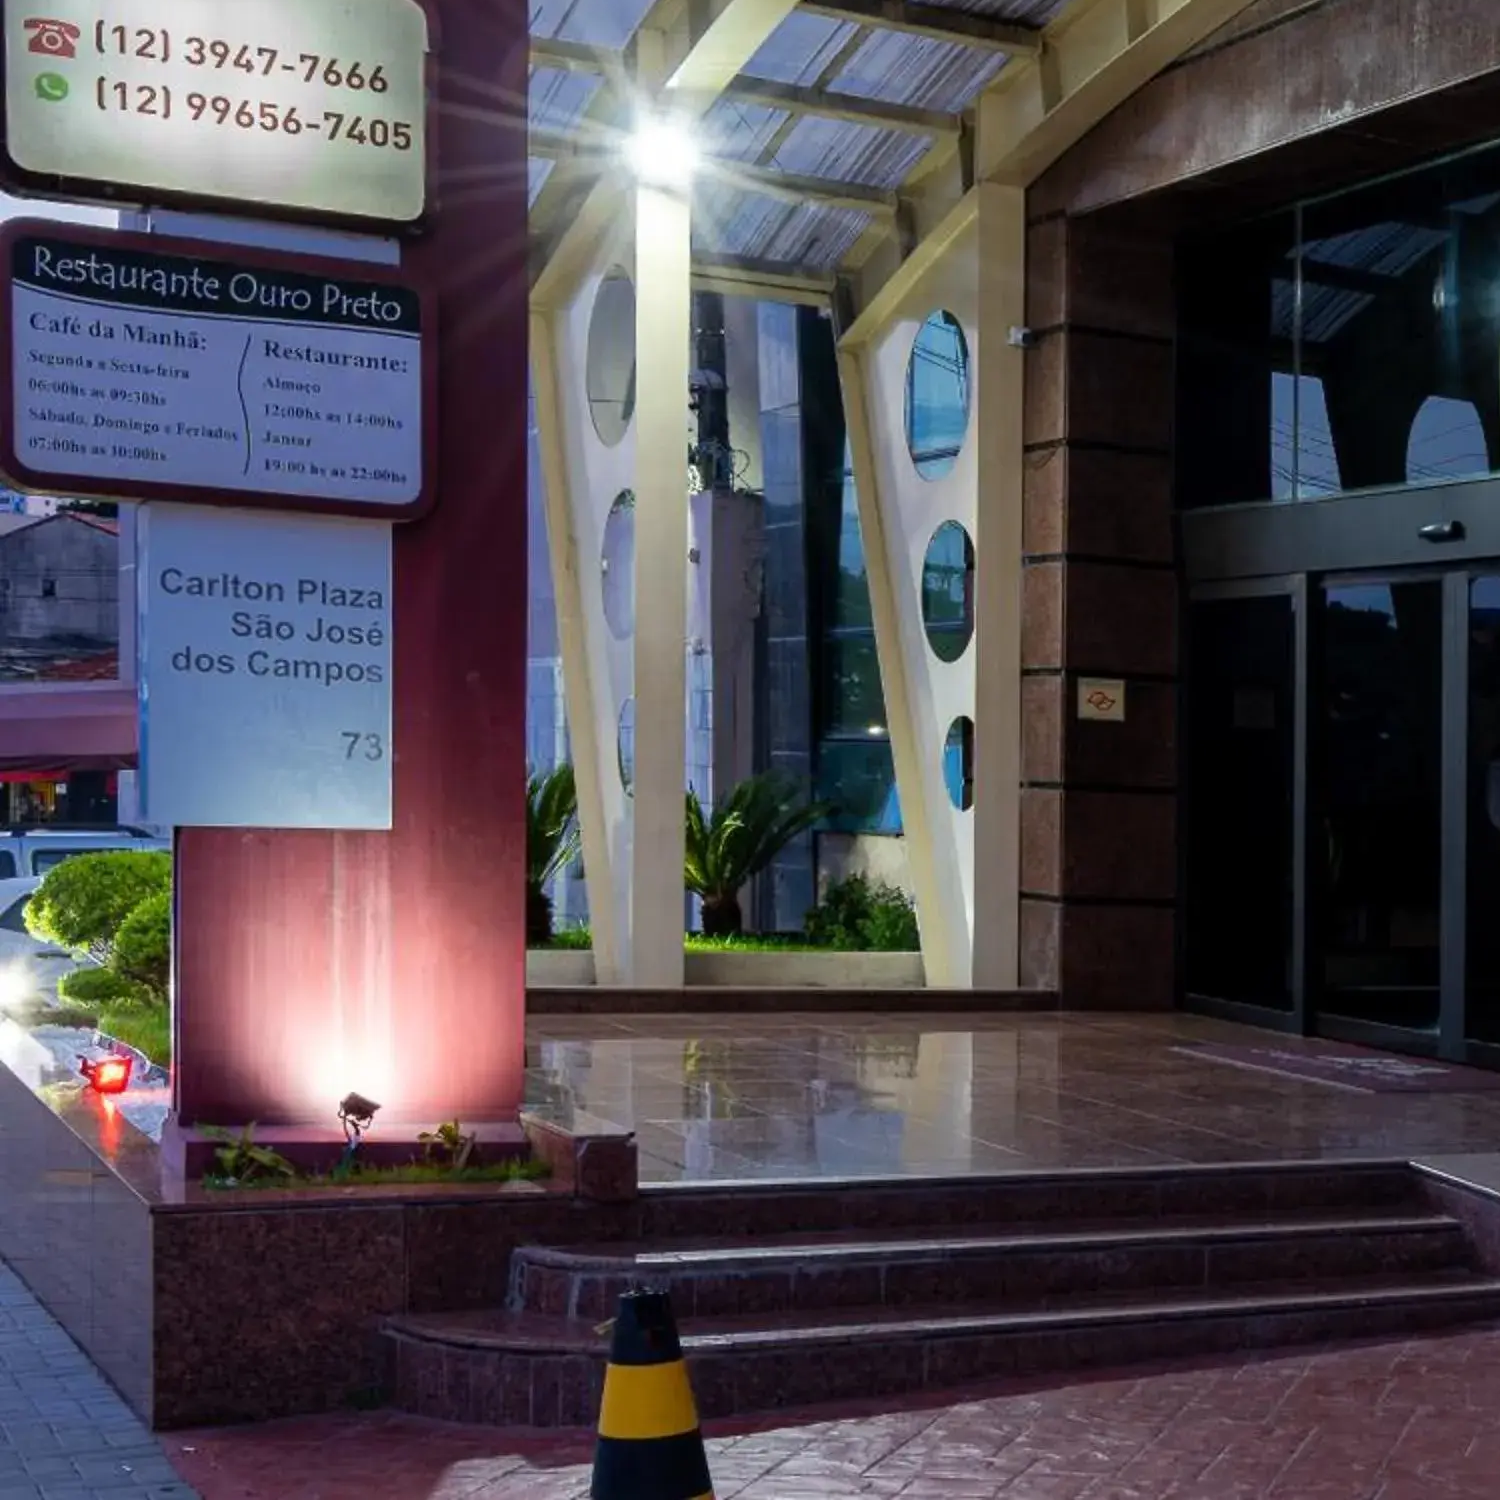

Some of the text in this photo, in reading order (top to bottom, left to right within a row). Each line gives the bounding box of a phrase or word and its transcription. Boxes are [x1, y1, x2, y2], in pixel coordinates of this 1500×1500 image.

[95, 19, 389, 94] (12) 3947-7666
[96, 76, 412, 151] (12) 99656-7405
[34, 245, 402, 322] Restaurante Ouro Preto
[29, 312, 208, 351] Café da Manhã:
[28, 350, 93, 370] Segunda
[263, 340, 408, 373] Restaurante:
[263, 377, 322, 395] Almoço
[92, 414, 160, 435] Domingo
[262, 430, 312, 447] Jantar
[160, 568, 383, 610] Carlton Plaza
[231, 611, 384, 647] São José
[171, 646, 383, 687] dos Campos
[341, 732, 384, 762] 73
